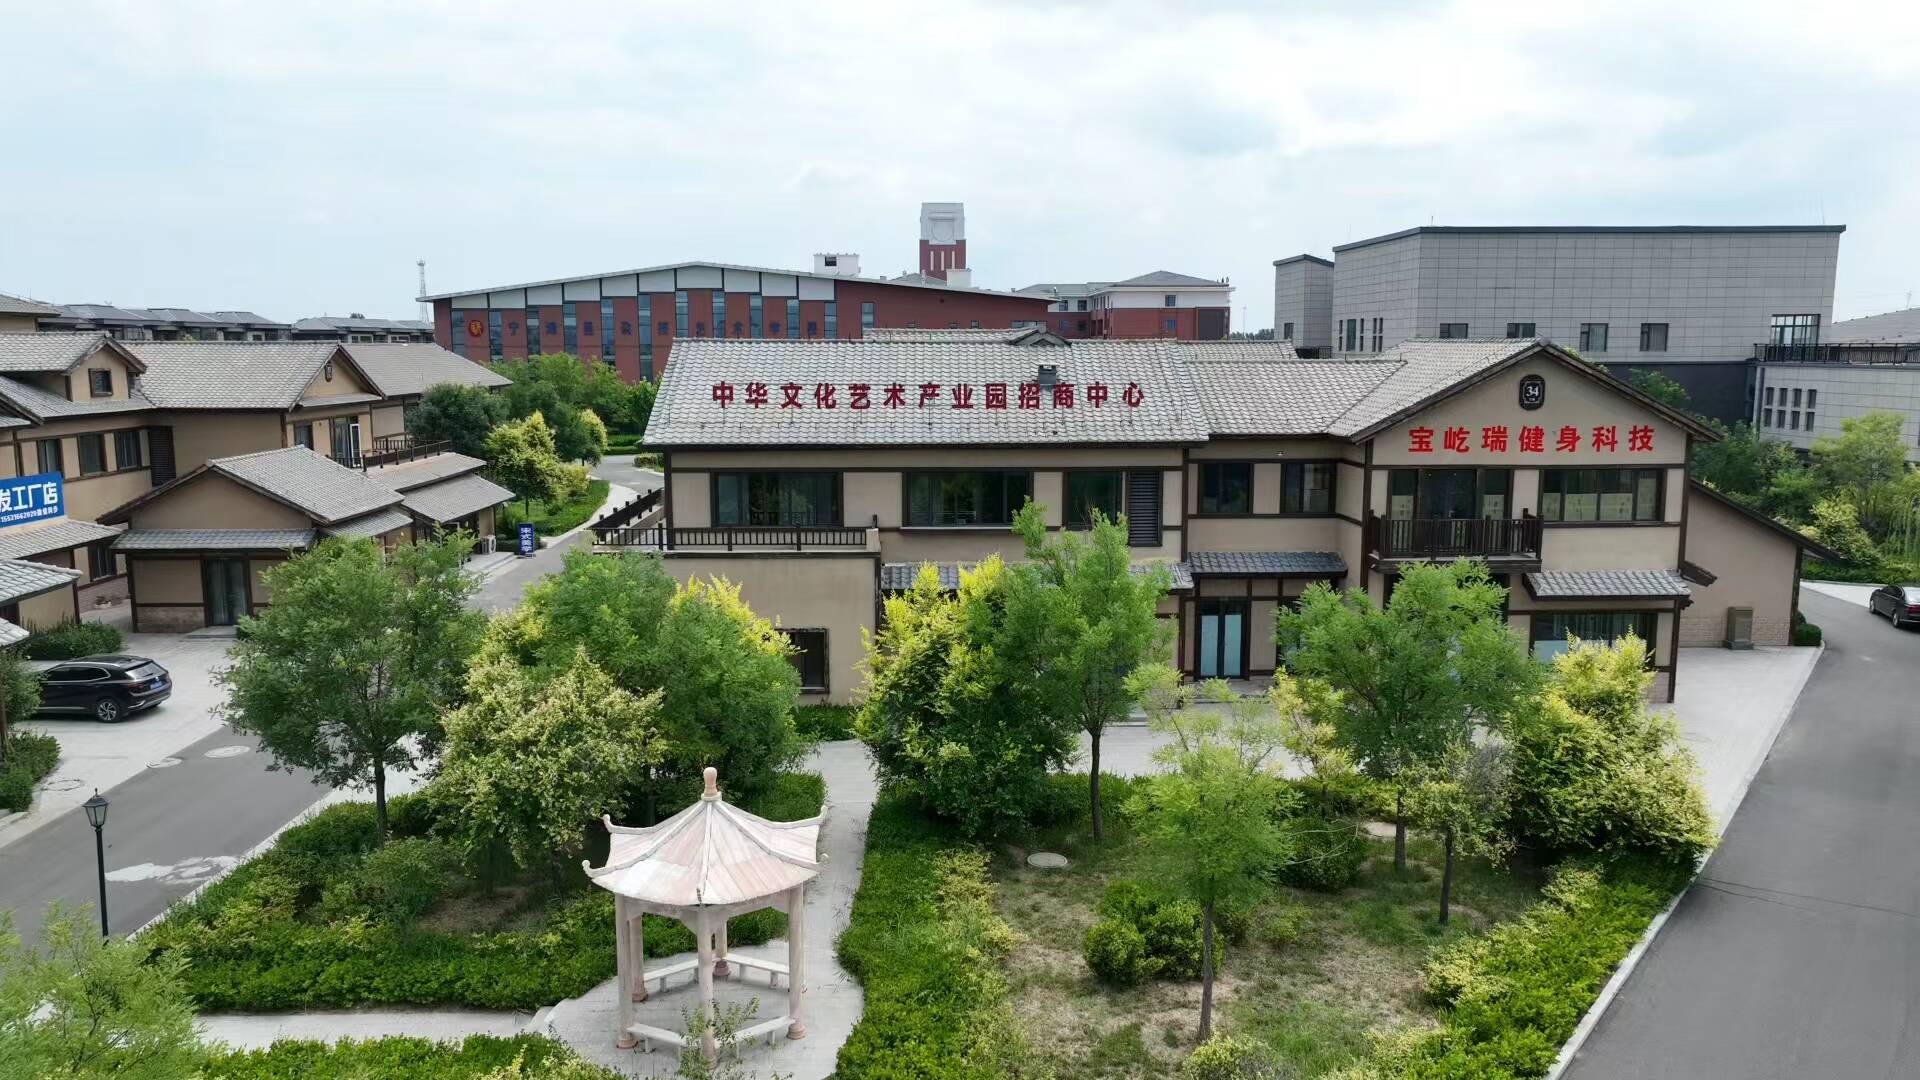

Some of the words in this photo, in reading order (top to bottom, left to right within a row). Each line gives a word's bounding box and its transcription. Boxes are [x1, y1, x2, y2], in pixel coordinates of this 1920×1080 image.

[712, 381, 1144, 409] 中华文化艺术产业园招商中心
[1525, 385, 1539, 397] 34
[1408, 425, 1655, 452] 宝屹瑞健身科技
